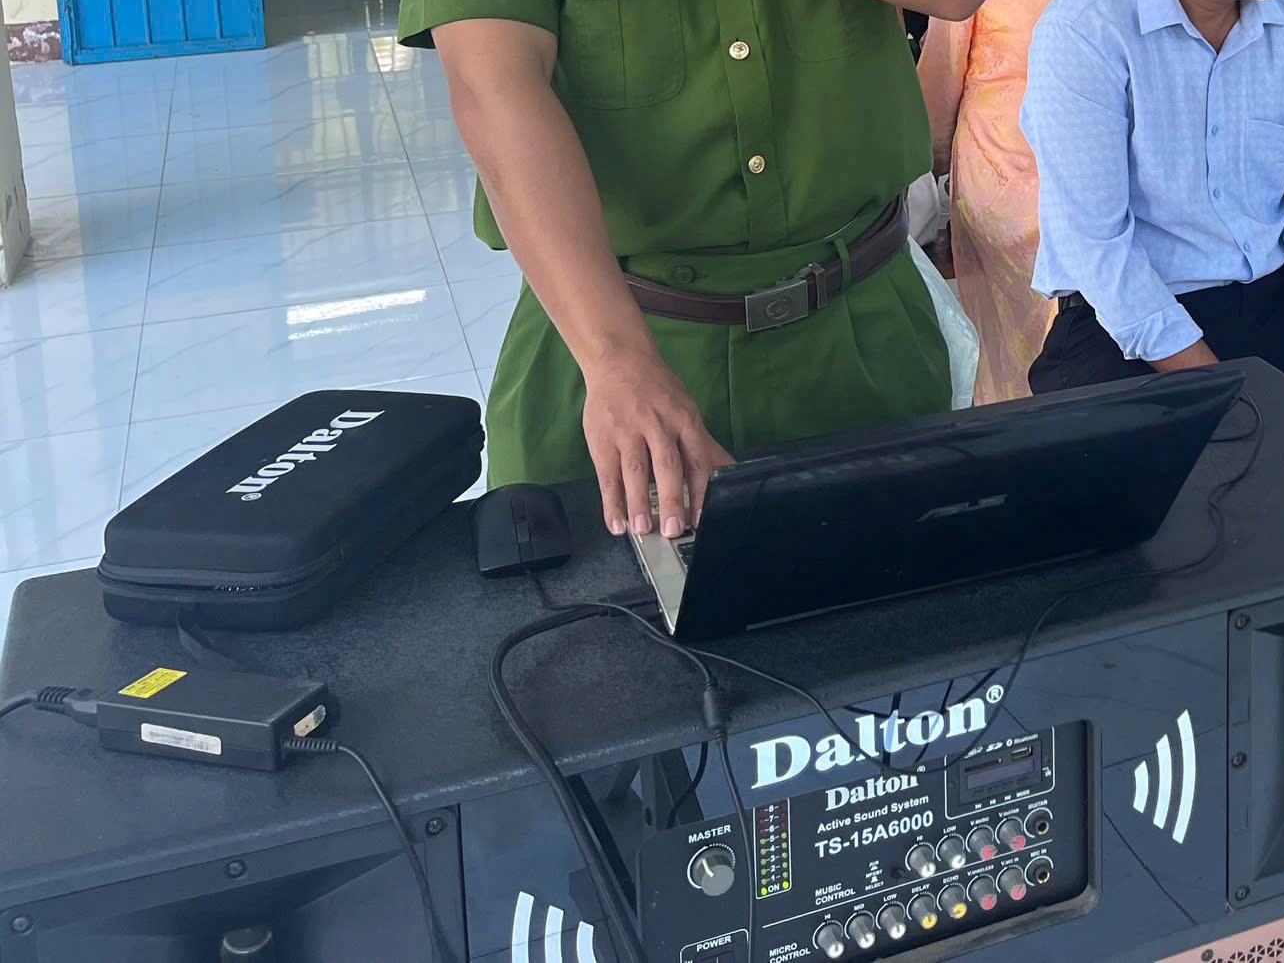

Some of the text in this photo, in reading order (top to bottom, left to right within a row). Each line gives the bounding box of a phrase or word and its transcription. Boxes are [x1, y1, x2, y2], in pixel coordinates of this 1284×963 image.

[817, 796, 929, 834] Active Sound System
[688, 824, 732, 844] MASTER
[815, 810, 934, 858] TS-15A6000
[943, 825, 957, 834] LOW
[943, 875, 959, 884] ECHO
[767, 884, 780, 893] ON
[815, 883, 842, 897] MUSIC
[911, 883, 930, 894] DELAY
[815, 888, 856, 905] CONTROL
[883, 893, 897, 902] LOW
[696, 935, 732, 953] POWER
[769, 942, 798, 957] MICRO
[769, 947, 811, 963] CONTROL
